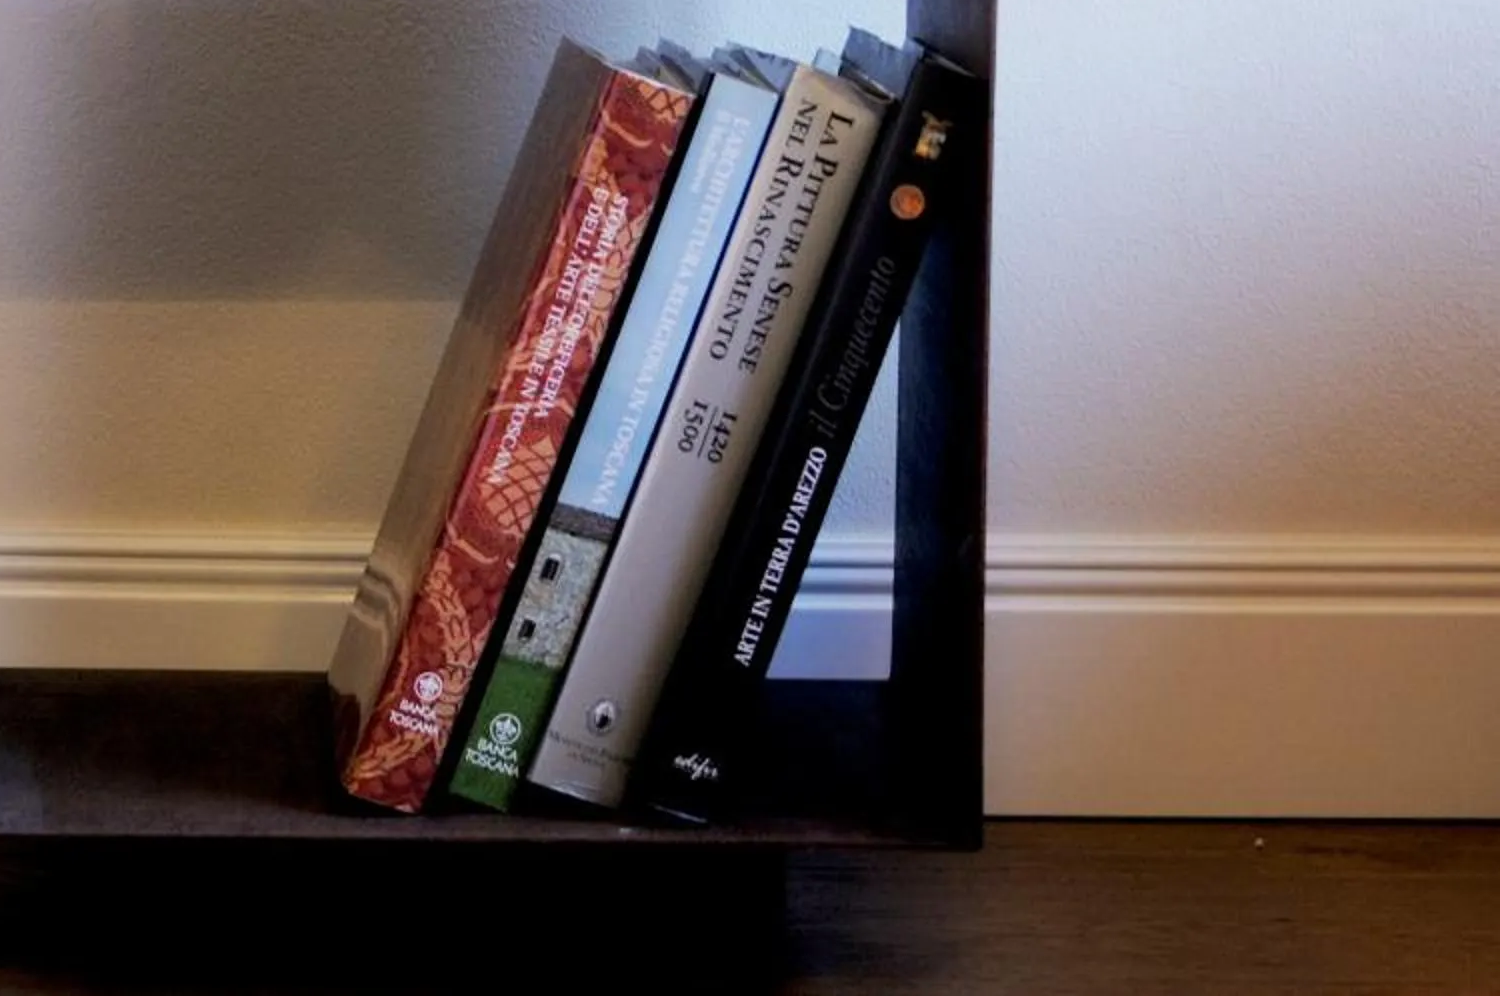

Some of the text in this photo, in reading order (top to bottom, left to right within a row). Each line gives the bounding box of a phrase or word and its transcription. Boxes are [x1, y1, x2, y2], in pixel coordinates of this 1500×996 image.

[592, 192, 629, 261] STORIA
[527, 301, 566, 376] TESSILE
[519, 375, 539, 400] IN
[626, 386, 649, 413] IN
[486, 400, 530, 487] TOSCANA
[675, 398, 709, 454] 1500
[705, 408, 738, 465] 1420
[590, 414, 639, 508] TOSCANA
[734, 444, 829, 667] ARTE IN TERRA D'AREZZO
[466, 748, 519, 778] TOSCANA
[477, 738, 517, 761] BANCA
